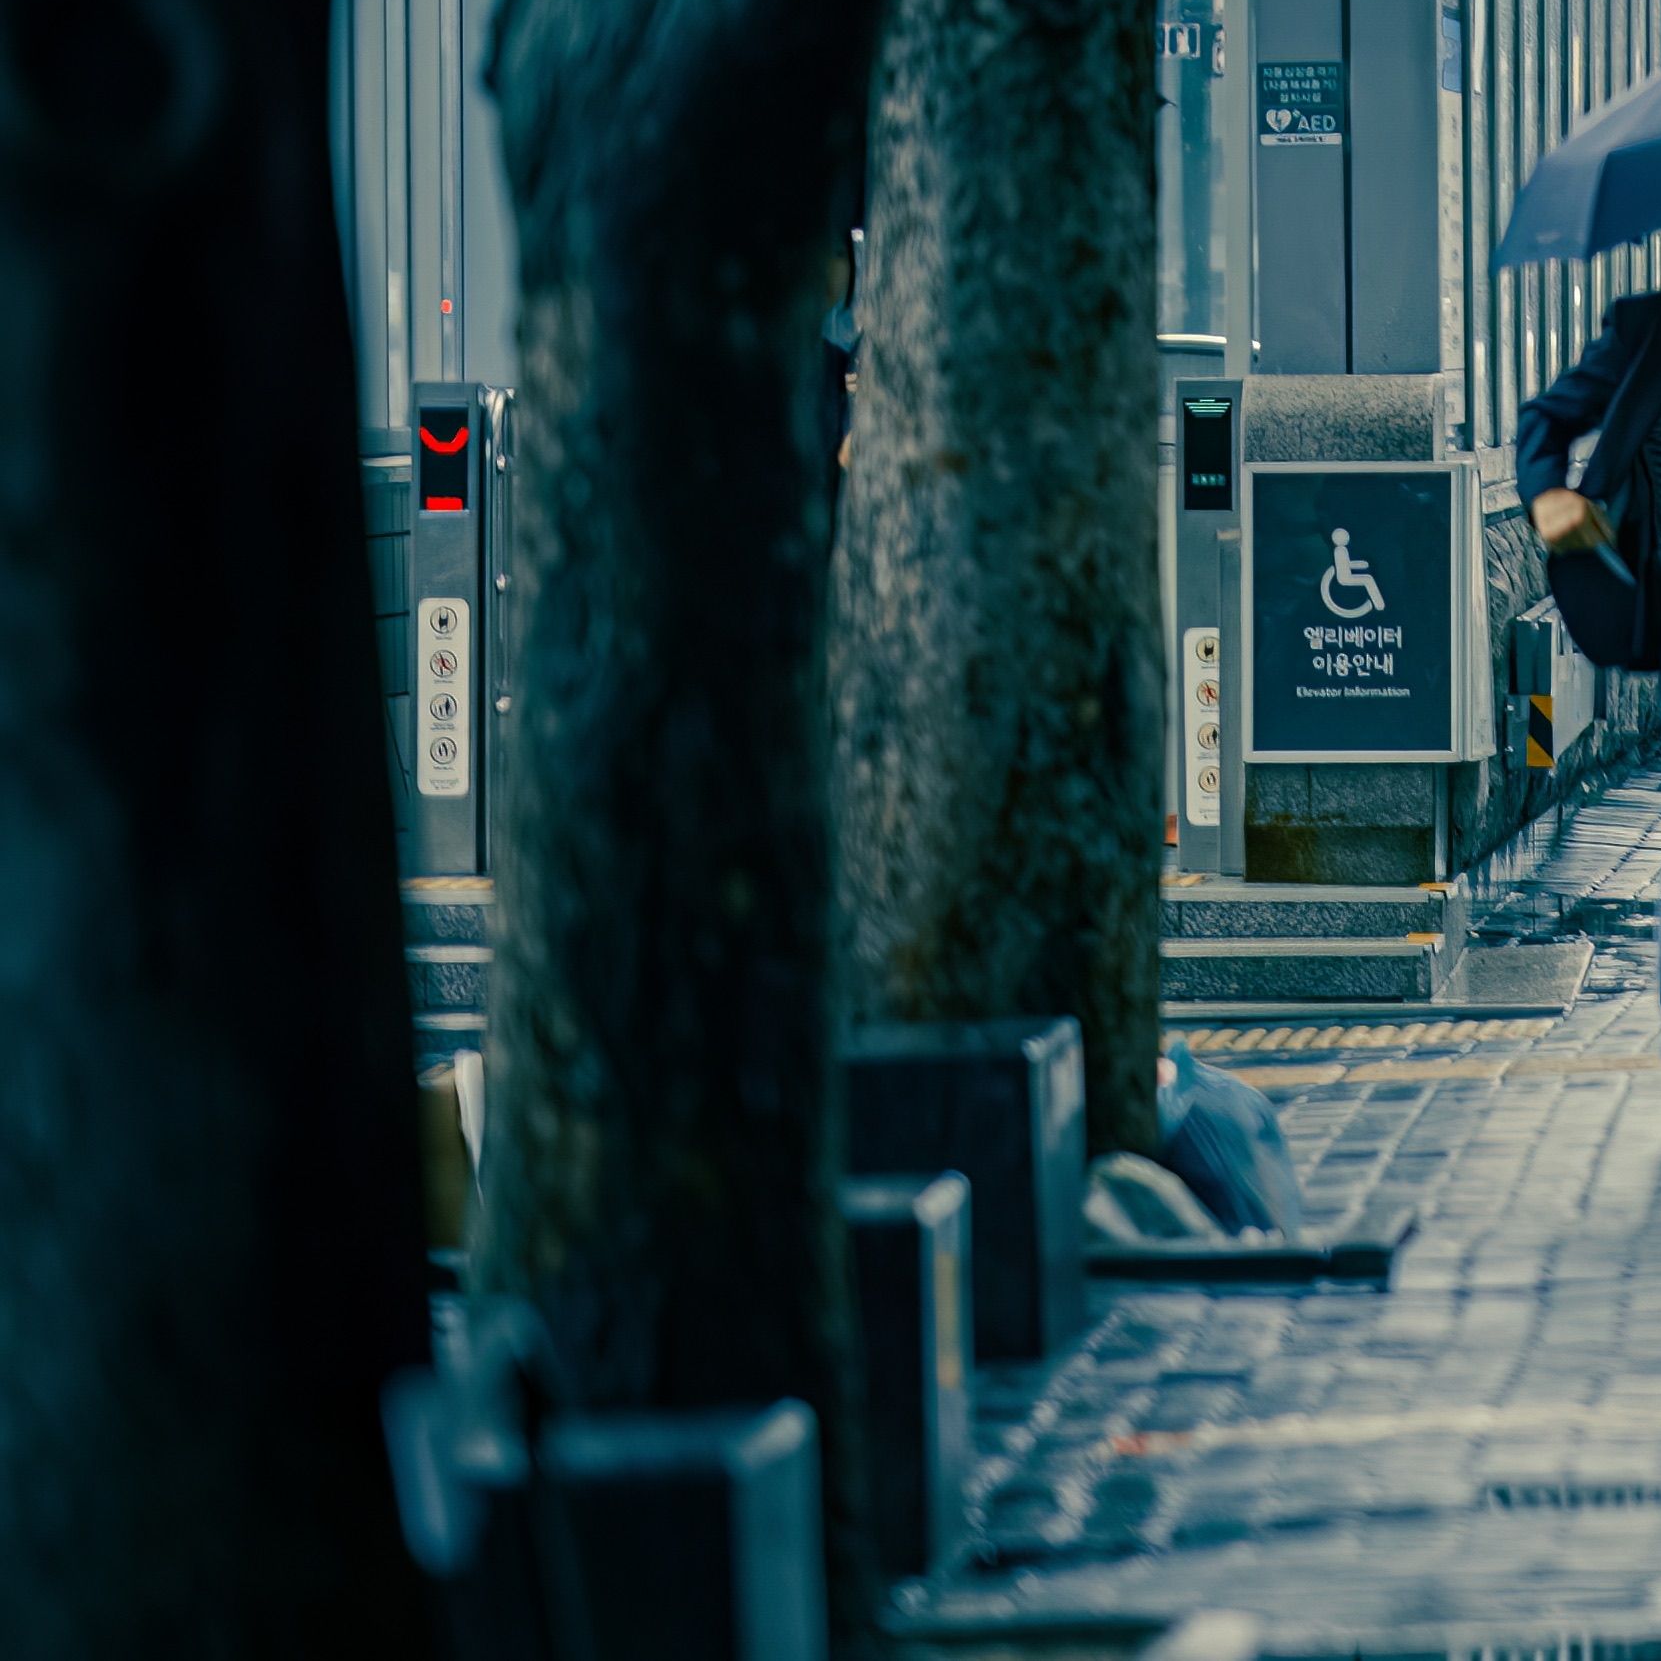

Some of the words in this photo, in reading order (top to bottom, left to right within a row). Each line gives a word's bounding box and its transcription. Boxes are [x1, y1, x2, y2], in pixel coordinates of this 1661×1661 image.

[1297, 114, 1336, 131] AED
[1303, 625, 1402, 650] 엘리베이터
[1312, 652, 1394, 677] 이용안내
[1296, 685, 1342, 698] Elevator
[1344, 685, 1411, 698] Information
